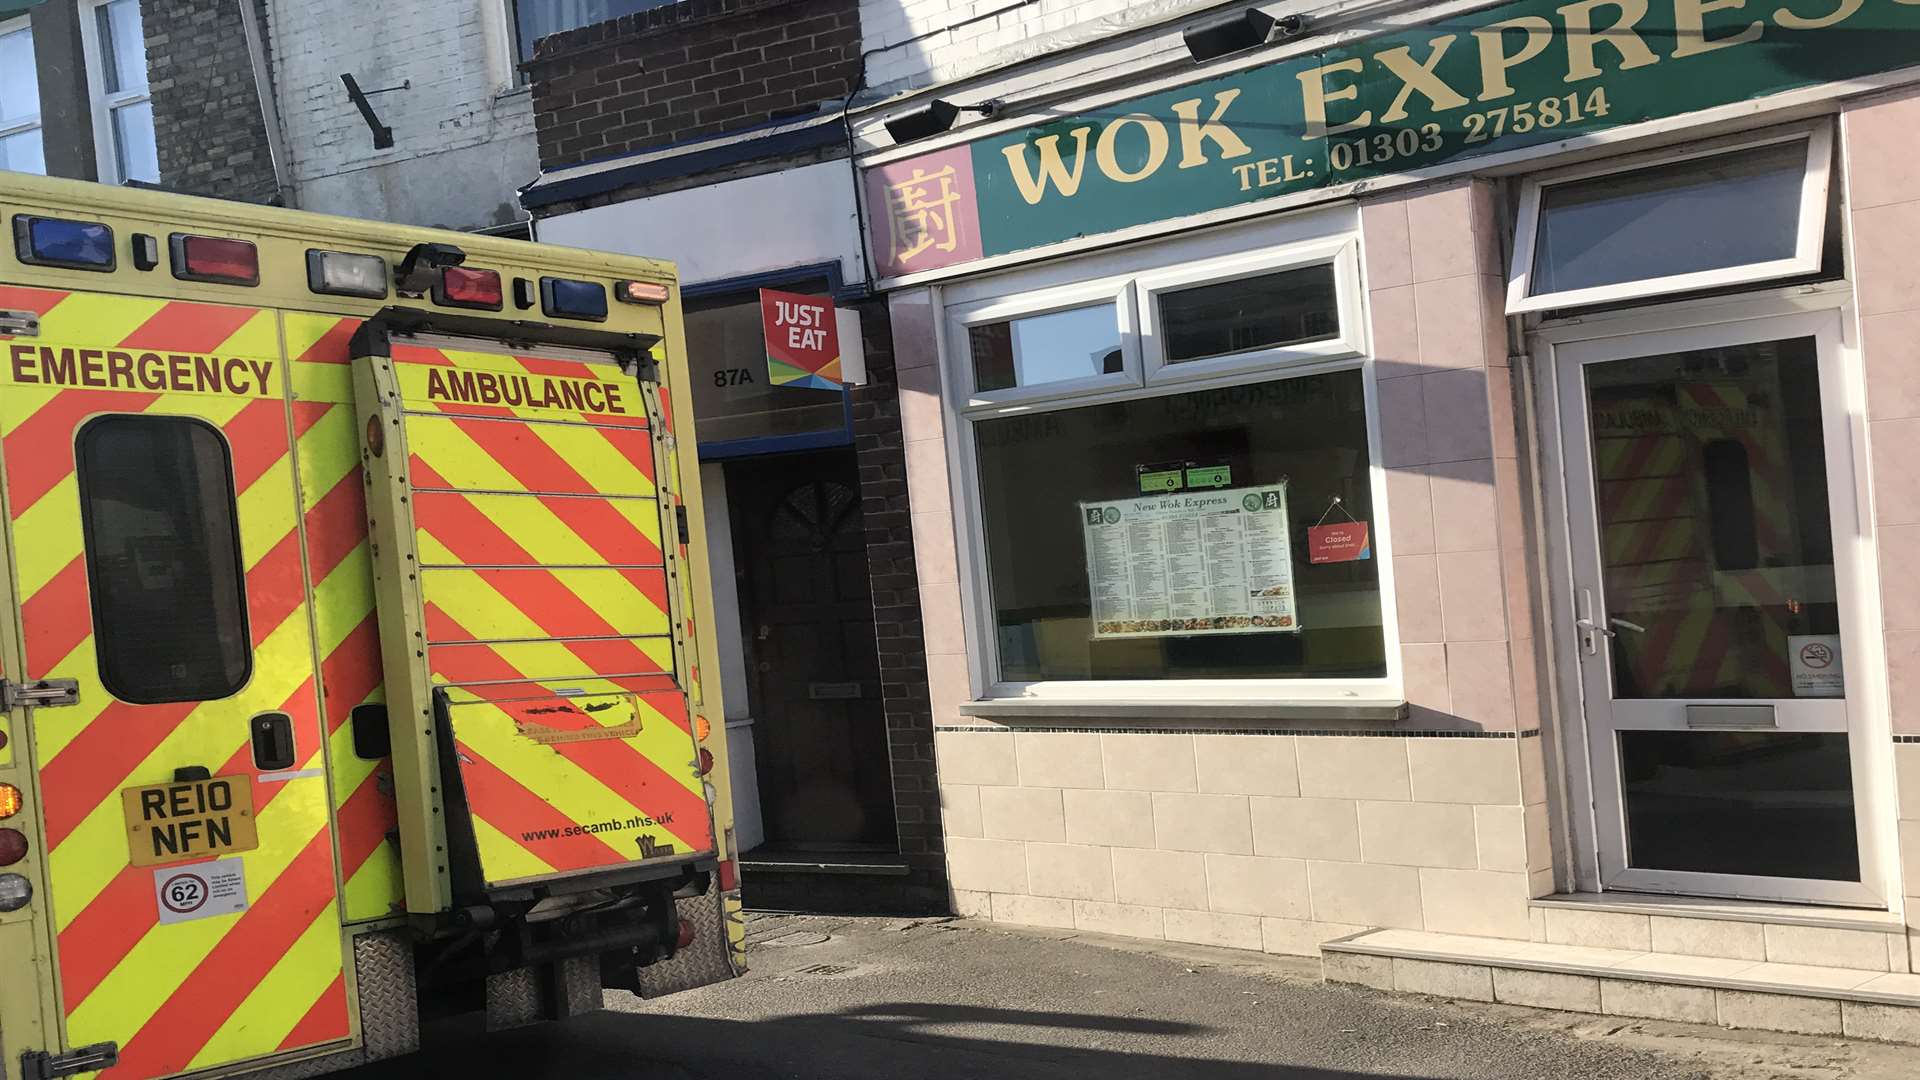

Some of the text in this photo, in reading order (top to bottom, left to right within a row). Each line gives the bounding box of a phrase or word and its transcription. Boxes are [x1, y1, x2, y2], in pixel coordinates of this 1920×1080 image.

[1001, 0, 1920, 205] WOK EXPRE
[1232, 86, 1610, 192] TEL: 01303 275814
[884, 163, 961, 267] 廚
[775, 301, 825, 328] JUST
[788, 326, 827, 351] EAT
[10, 344, 273, 395] EMERGENCY
[713, 368, 754, 388] 87A
[428, 368, 626, 414] AMBULANCE
[1133, 496, 1228, 512] New Wok Express
[1325, 535, 1352, 543] Closed
[141, 780, 232, 821] RE10
[151, 816, 232, 857] NFN
[522, 811, 674, 842] www.secamb.nhs.uk
[171, 883, 199, 902] 62
